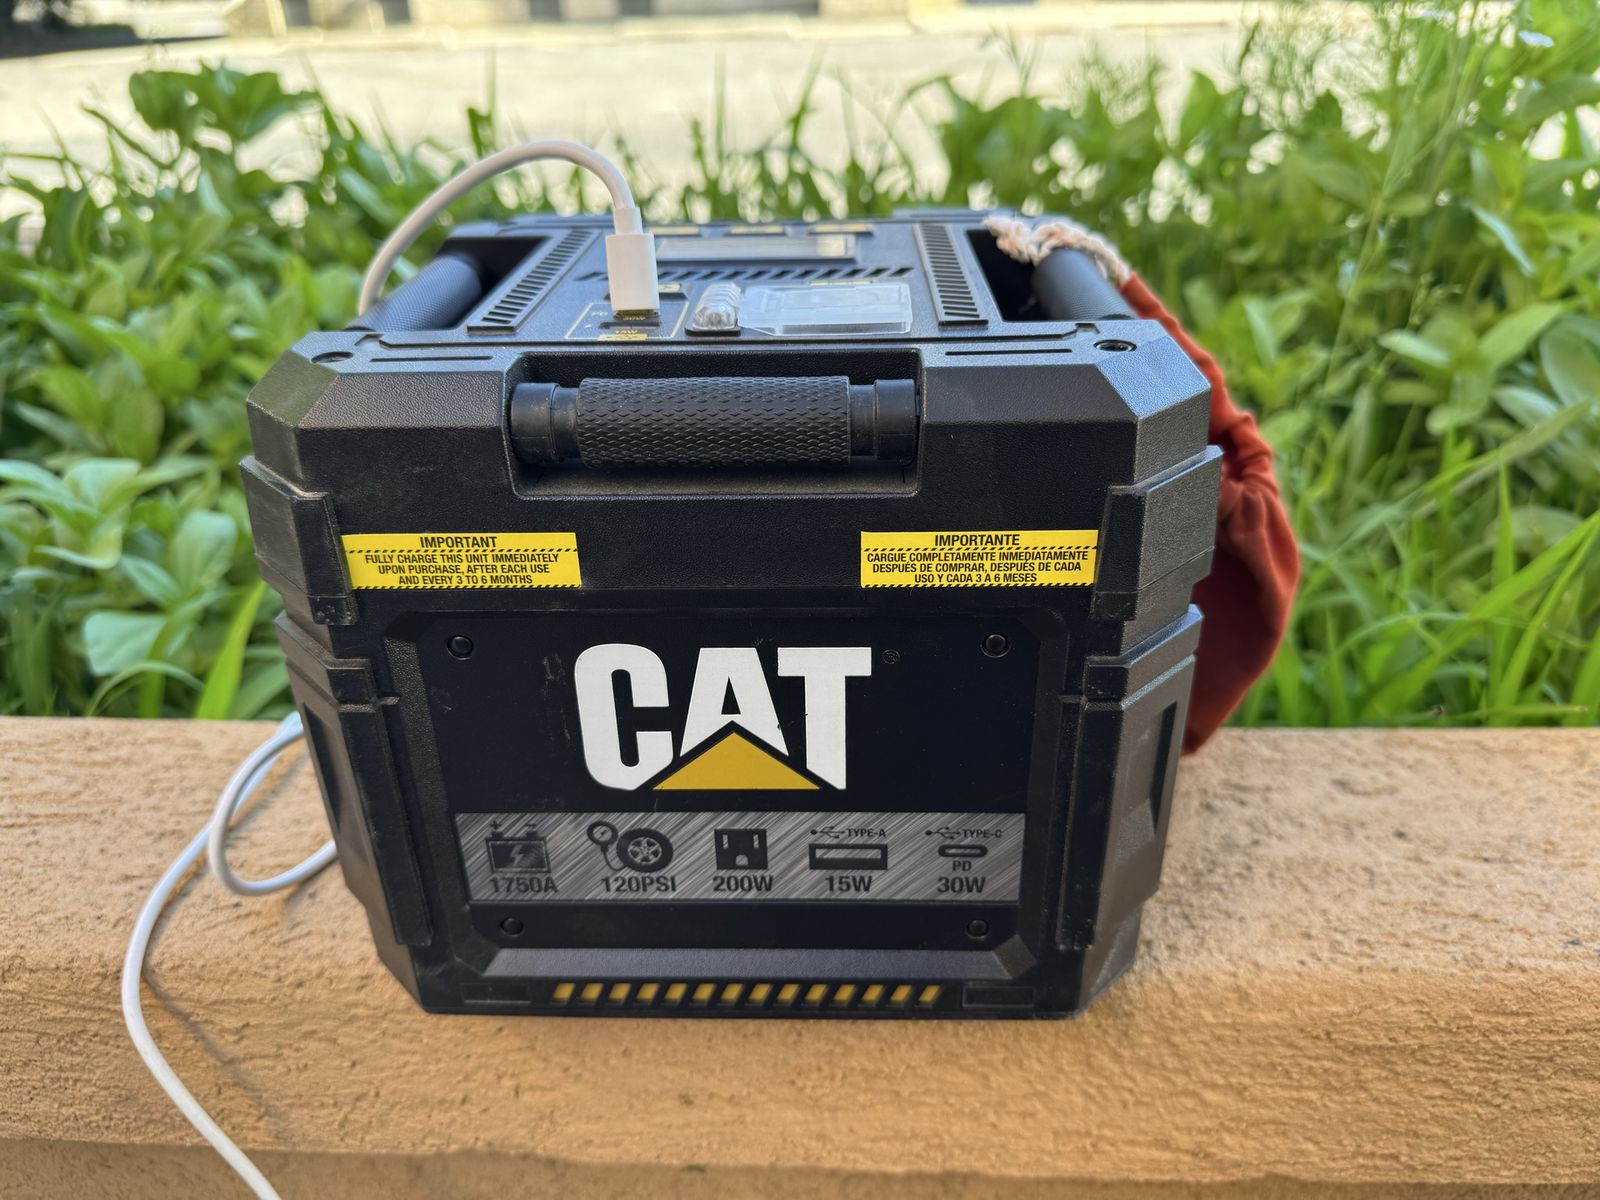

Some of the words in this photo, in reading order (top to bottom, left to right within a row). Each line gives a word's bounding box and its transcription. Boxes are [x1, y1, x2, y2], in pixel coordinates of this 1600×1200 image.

[420, 536, 497, 548] IMPORTANT
[934, 534, 1020, 546] IMPORTANTE
[365, 554, 394, 564] FULLY
[397, 554, 437, 563] CHARGE
[440, 554, 463, 563] THIS
[466, 554, 489, 562] UNIT
[492, 553, 559, 562] IMMEDIATELY
[867, 553, 906, 562] CARGUE
[909, 552, 996, 562] COMPLETAMENTE
[1000, 551, 1088, 560] INMEDIATAMENTE
[378, 564, 404, 575] UPON
[408, 564, 465, 575] PURCHASE,
[467, 564, 498, 574] AFTER
[501, 564, 527, 574] EACH
[530, 564, 550, 573] USE
[872, 562, 917, 573] DESPUÉS
[920, 563, 933, 572] DE
[935, 563, 988, 573] COMPRAR,
[990, 560, 1035, 572] DESPUÉS
[1038, 562, 1051, 571] DE
[1054, 562, 1081, 571] CADA
[399, 575, 420, 585] AND
[423, 575, 453, 584] EVERY
[456, 575, 463, 584] 3
[466, 575, 479, 584] TO
[481, 575, 488, 584] 6
[491, 575, 533, 584] MONTHS
[914, 574, 935, 583] USO
[938, 574, 944, 583] Y
[946, 574, 973, 583] CADA
[975, 573, 982, 582] 3
[985, 573, 992, 582] A
[994, 573, 1001, 582] 6
[1003, 573, 1037, 582] MESES
[574, 643, 872, 790] CAT
[848, 828, 886, 838] TYPE-A
[962, 829, 1002, 838] TYPE-C
[952, 860, 972, 872] PD
[490, 876, 558, 893] 1750A
[602, 875, 676, 892] 120PSI
[713, 874, 773, 892] 200W
[825, 875, 872, 892] 15W
[937, 876, 986, 893] 30W
